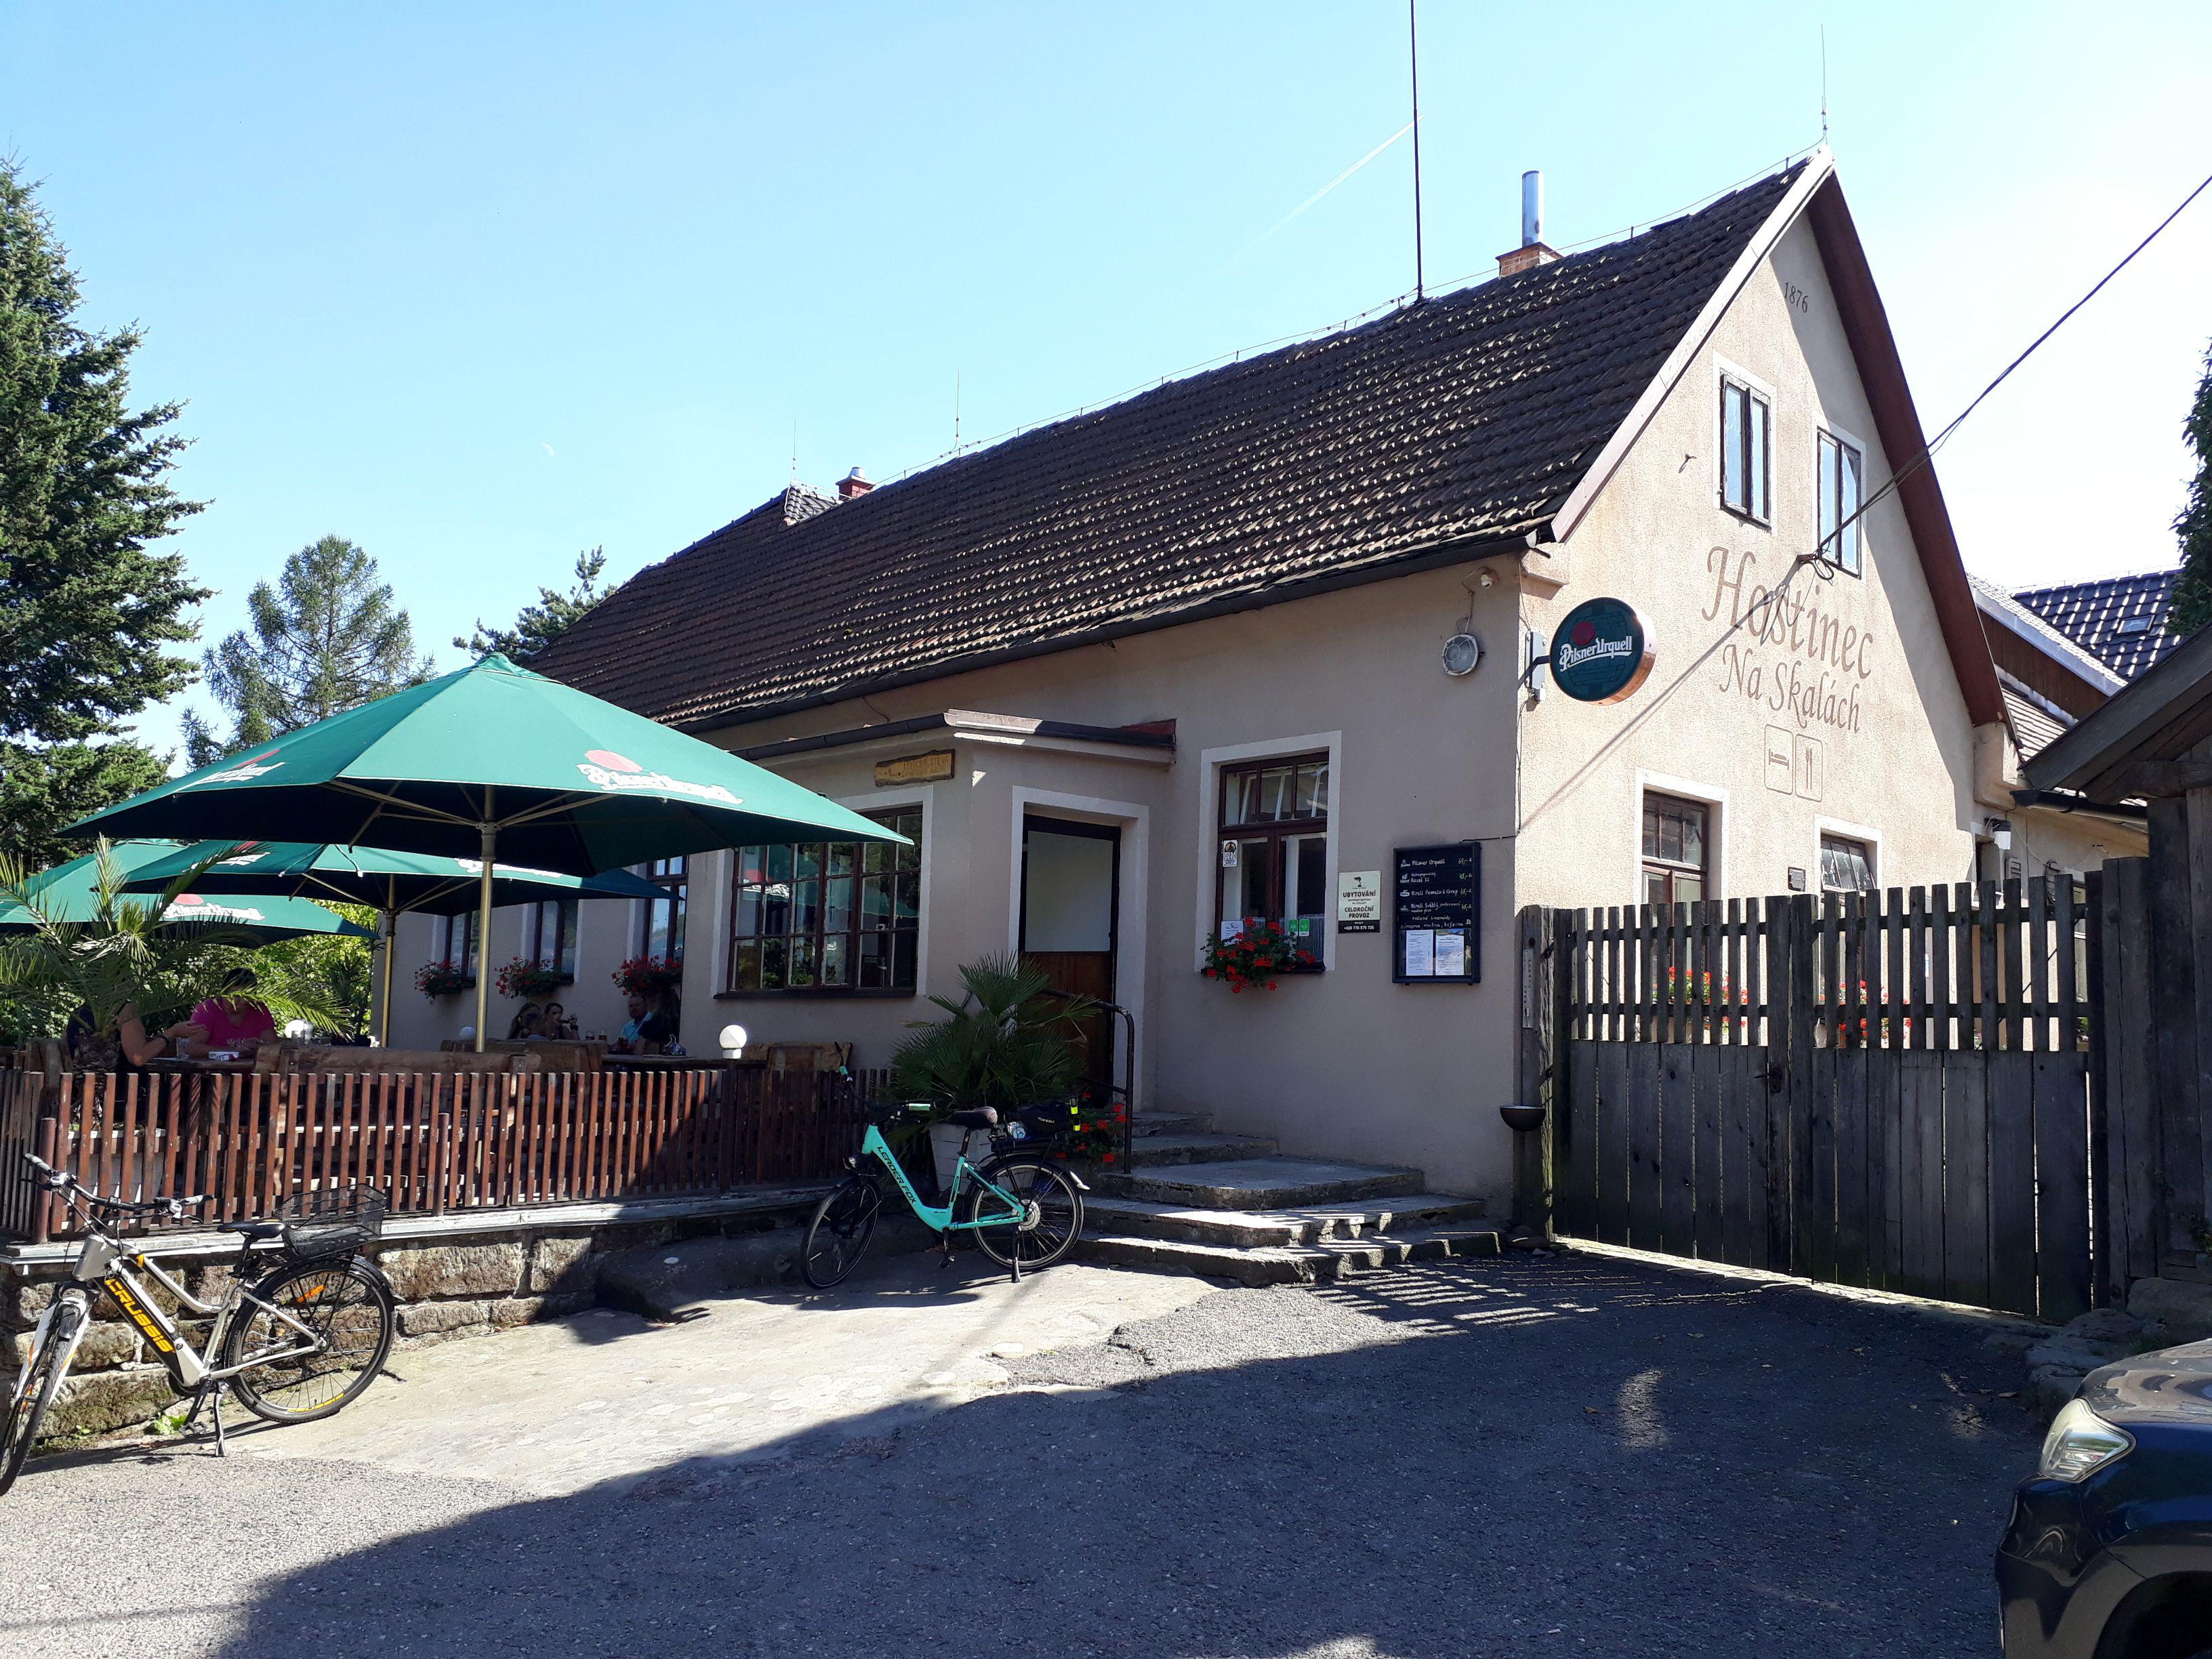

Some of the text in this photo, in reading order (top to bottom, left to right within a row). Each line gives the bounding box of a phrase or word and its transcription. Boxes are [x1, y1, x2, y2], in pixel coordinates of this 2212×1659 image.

[1784, 282, 1809, 313] 1876
[1702, 546, 1874, 678] Hostinec
[1559, 636, 1633, 672] Pilsner Urquell
[1719, 644, 1860, 734] Na Skalách
[1343, 889, 1376, 898] UBYTOVÁNÍ
[877, 1146, 917, 1204] LEADER FOX
